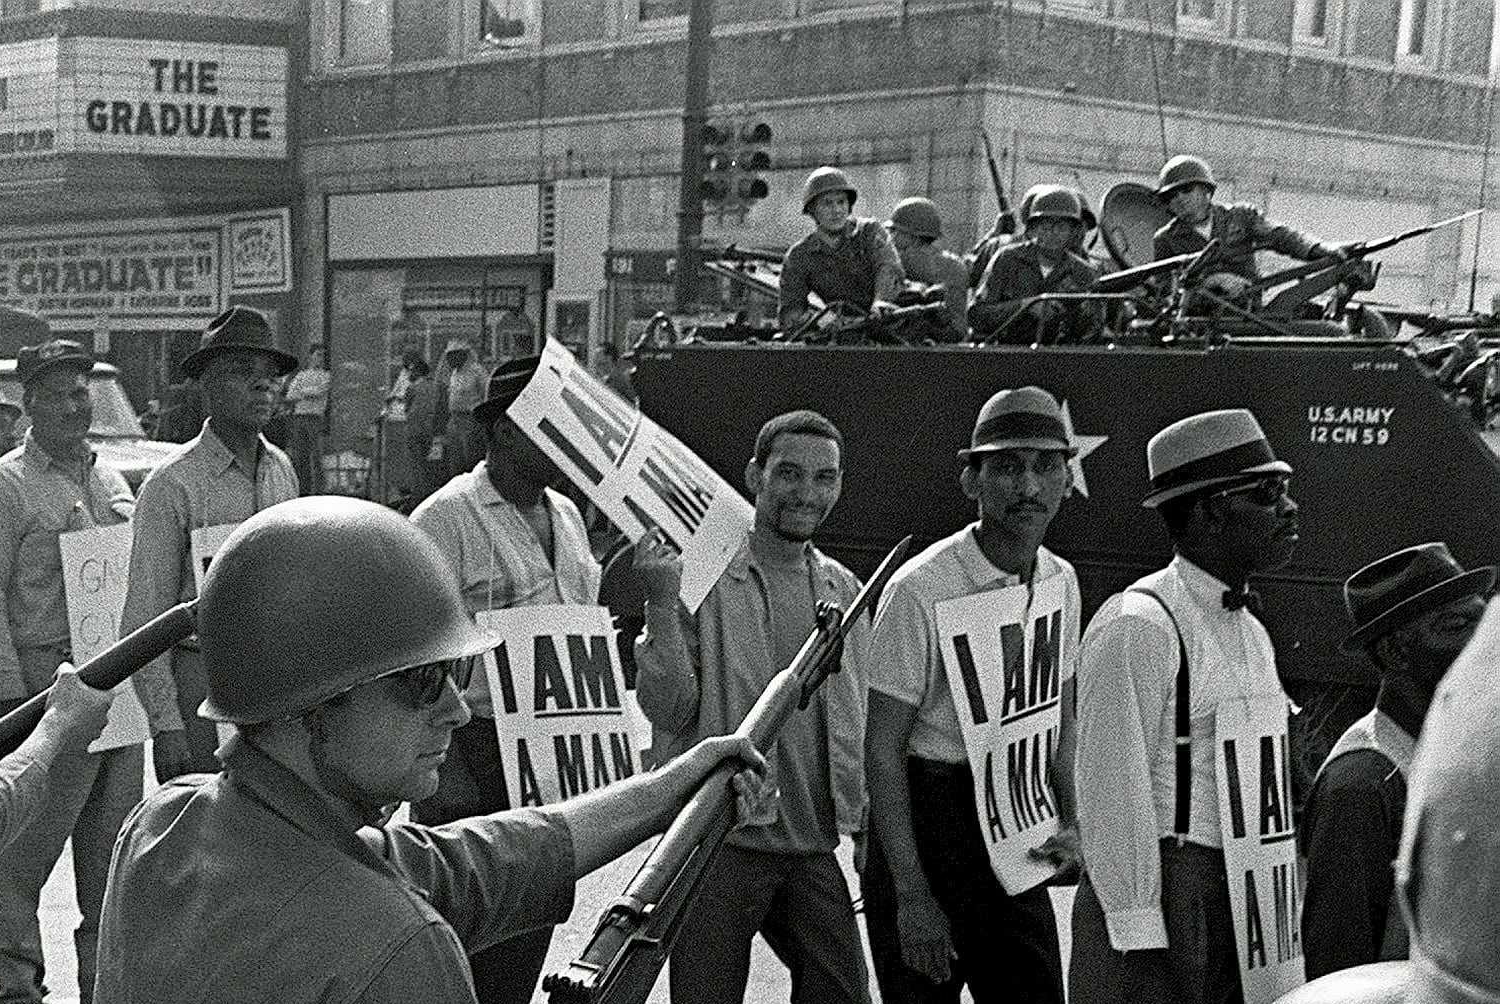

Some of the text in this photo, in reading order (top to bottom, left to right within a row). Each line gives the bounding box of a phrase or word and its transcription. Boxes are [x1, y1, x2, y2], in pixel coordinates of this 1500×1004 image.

[149, 58, 219, 95] THE
[86, 99, 272, 140] GRADUATE
[16, 255, 212, 294] GRADUATE"
[538, 417, 605, 487] I
[1310, 427, 1328, 443] 12
[494, 634, 622, 714] I AM
[952, 609, 1062, 725] I AM
[517, 732, 637, 807] A MAN
[984, 751, 1007, 844] A
[1223, 739, 1247, 839] I
[1245, 869, 1267, 970] A
